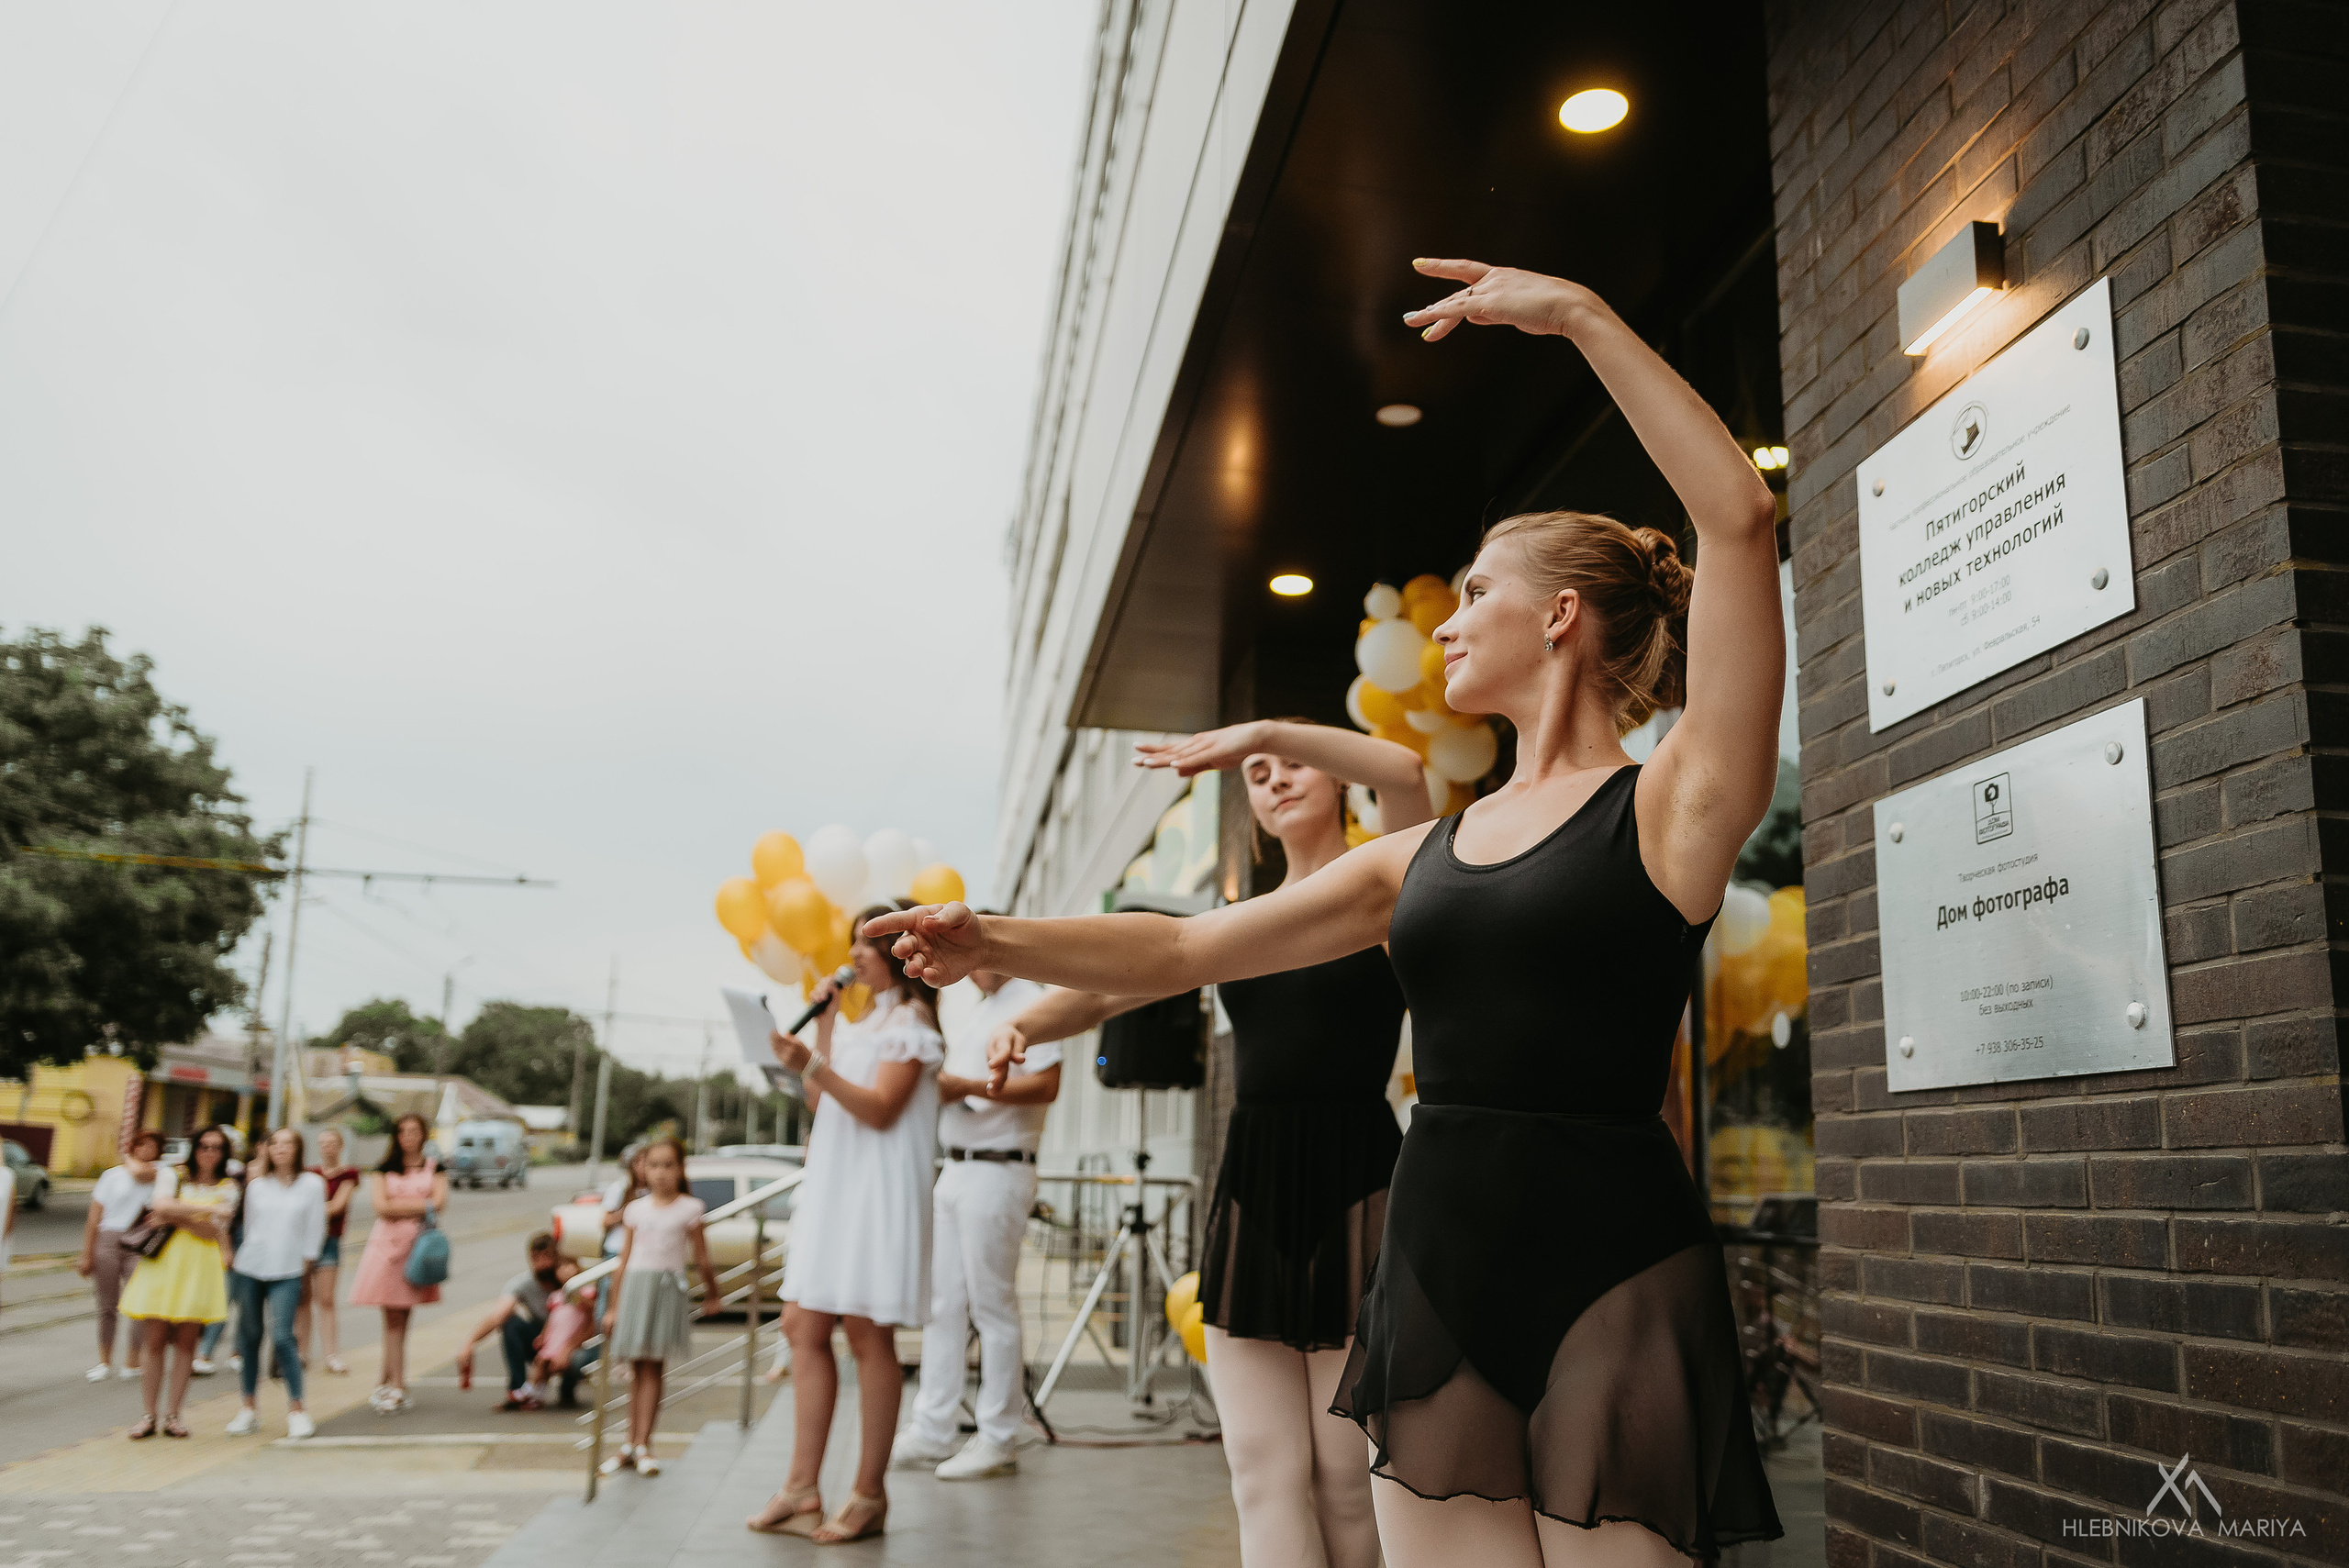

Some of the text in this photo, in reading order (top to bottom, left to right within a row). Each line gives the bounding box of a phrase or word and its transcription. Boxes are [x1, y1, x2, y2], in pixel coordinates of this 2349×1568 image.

[1926, 459, 2026, 540] Пятигорский
[1898, 538, 1962, 587] колледж
[1966, 473, 2065, 550] управления
[1904, 599, 1912, 613] и
[1916, 569, 1962, 606] новых
[1966, 503, 2065, 576] технологий
[1937, 875, 2070, 930] Дом фотографа
[1979, 1004, 1992, 1016] без
[2021, 974, 2054, 992] записи)
[2003, 1036, 2044, 1052] 306-35-25
